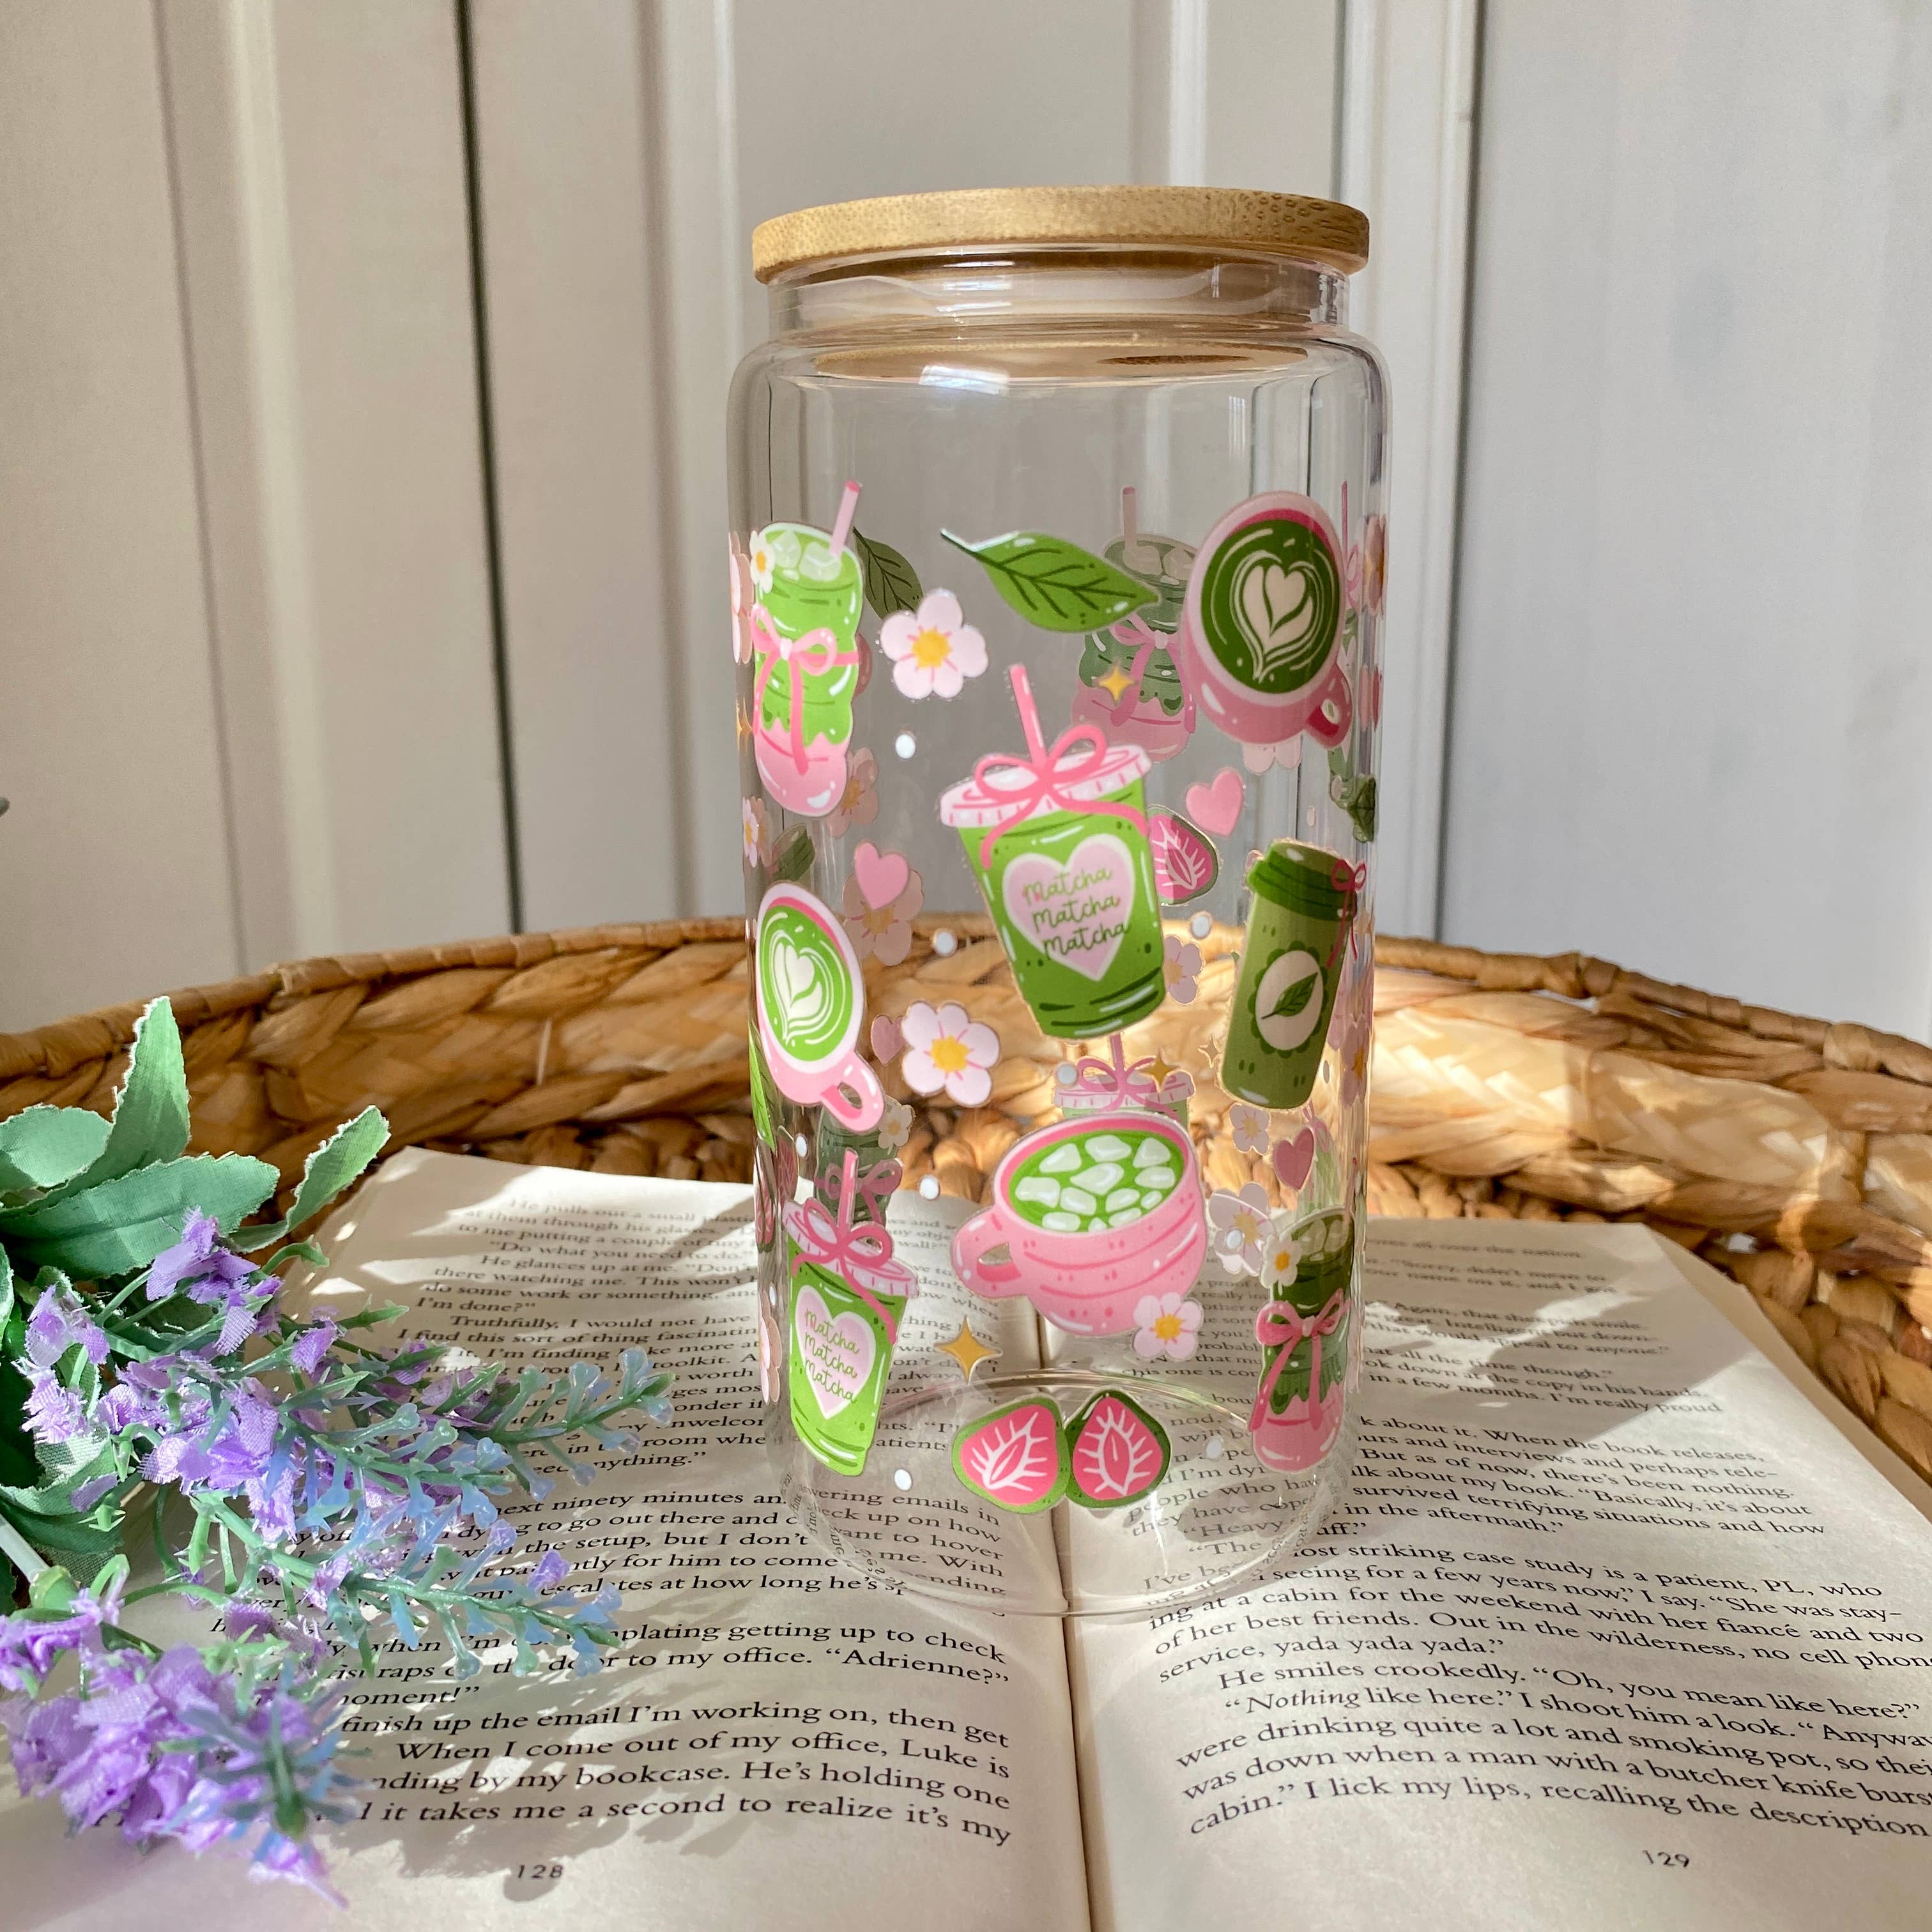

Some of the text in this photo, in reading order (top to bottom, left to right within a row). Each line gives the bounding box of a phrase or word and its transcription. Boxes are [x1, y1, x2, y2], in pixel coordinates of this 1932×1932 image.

[452, 1315, 558, 1330] Truthfully,
[570, 1319, 578, 1328] I
[587, 1318, 652, 1328] would
[704, 1315, 747, 1324] have
[1370, 1374, 1390, 1383] in
[1412, 1377, 1450, 1390] few
[1594, 1399, 1650, 1412] really
[537, 1510, 778, 1532] to go out there and
[892, 1496, 969, 1514] emails
[1353, 1485, 1823, 1533] survived terrifying situations and how
[880, 1551, 926, 1563] me.
[938, 1552, 1003, 1577] With
[931, 1535, 1003, 1563] hover
[1348, 1543, 1882, 1596] striking case study is a patient, PL, who
[1150, 1586, 1924, 1643] ing at a cabin for the weekend with her fiancé and two
[1155, 1611, 1850, 1665] of her best friends. Out in the wilderness, no cell
[629, 1646, 1008, 1685] to my office. “Adrienne?”
[728, 1622, 1006, 1664] getting up to check
[1219, 1660, 1919, 1719] He smiles crookedly. “Oh, you mean like here?”
[1225, 1687, 1795, 1737] “Nothing like here.” I shoot him a look.
[342, 1701, 1009, 1748] finish up the email I’m working on, then get
[1176, 1716, 1869, 1771] were drinking quite a lot and smoking pot, so
[397, 1731, 1009, 1778] When I come out of my office, Luke is
[1183, 1744, 1857, 1800] was down when a man with a butcher knife
[470, 1761, 1009, 1809] by my bookcase. He’s holding one
[1191, 1775, 1930, 1837] cabin.” I lick my lips, recalling the description
[518, 1864, 564, 1879] 128
[1644, 1850, 1690, 1867] 129
